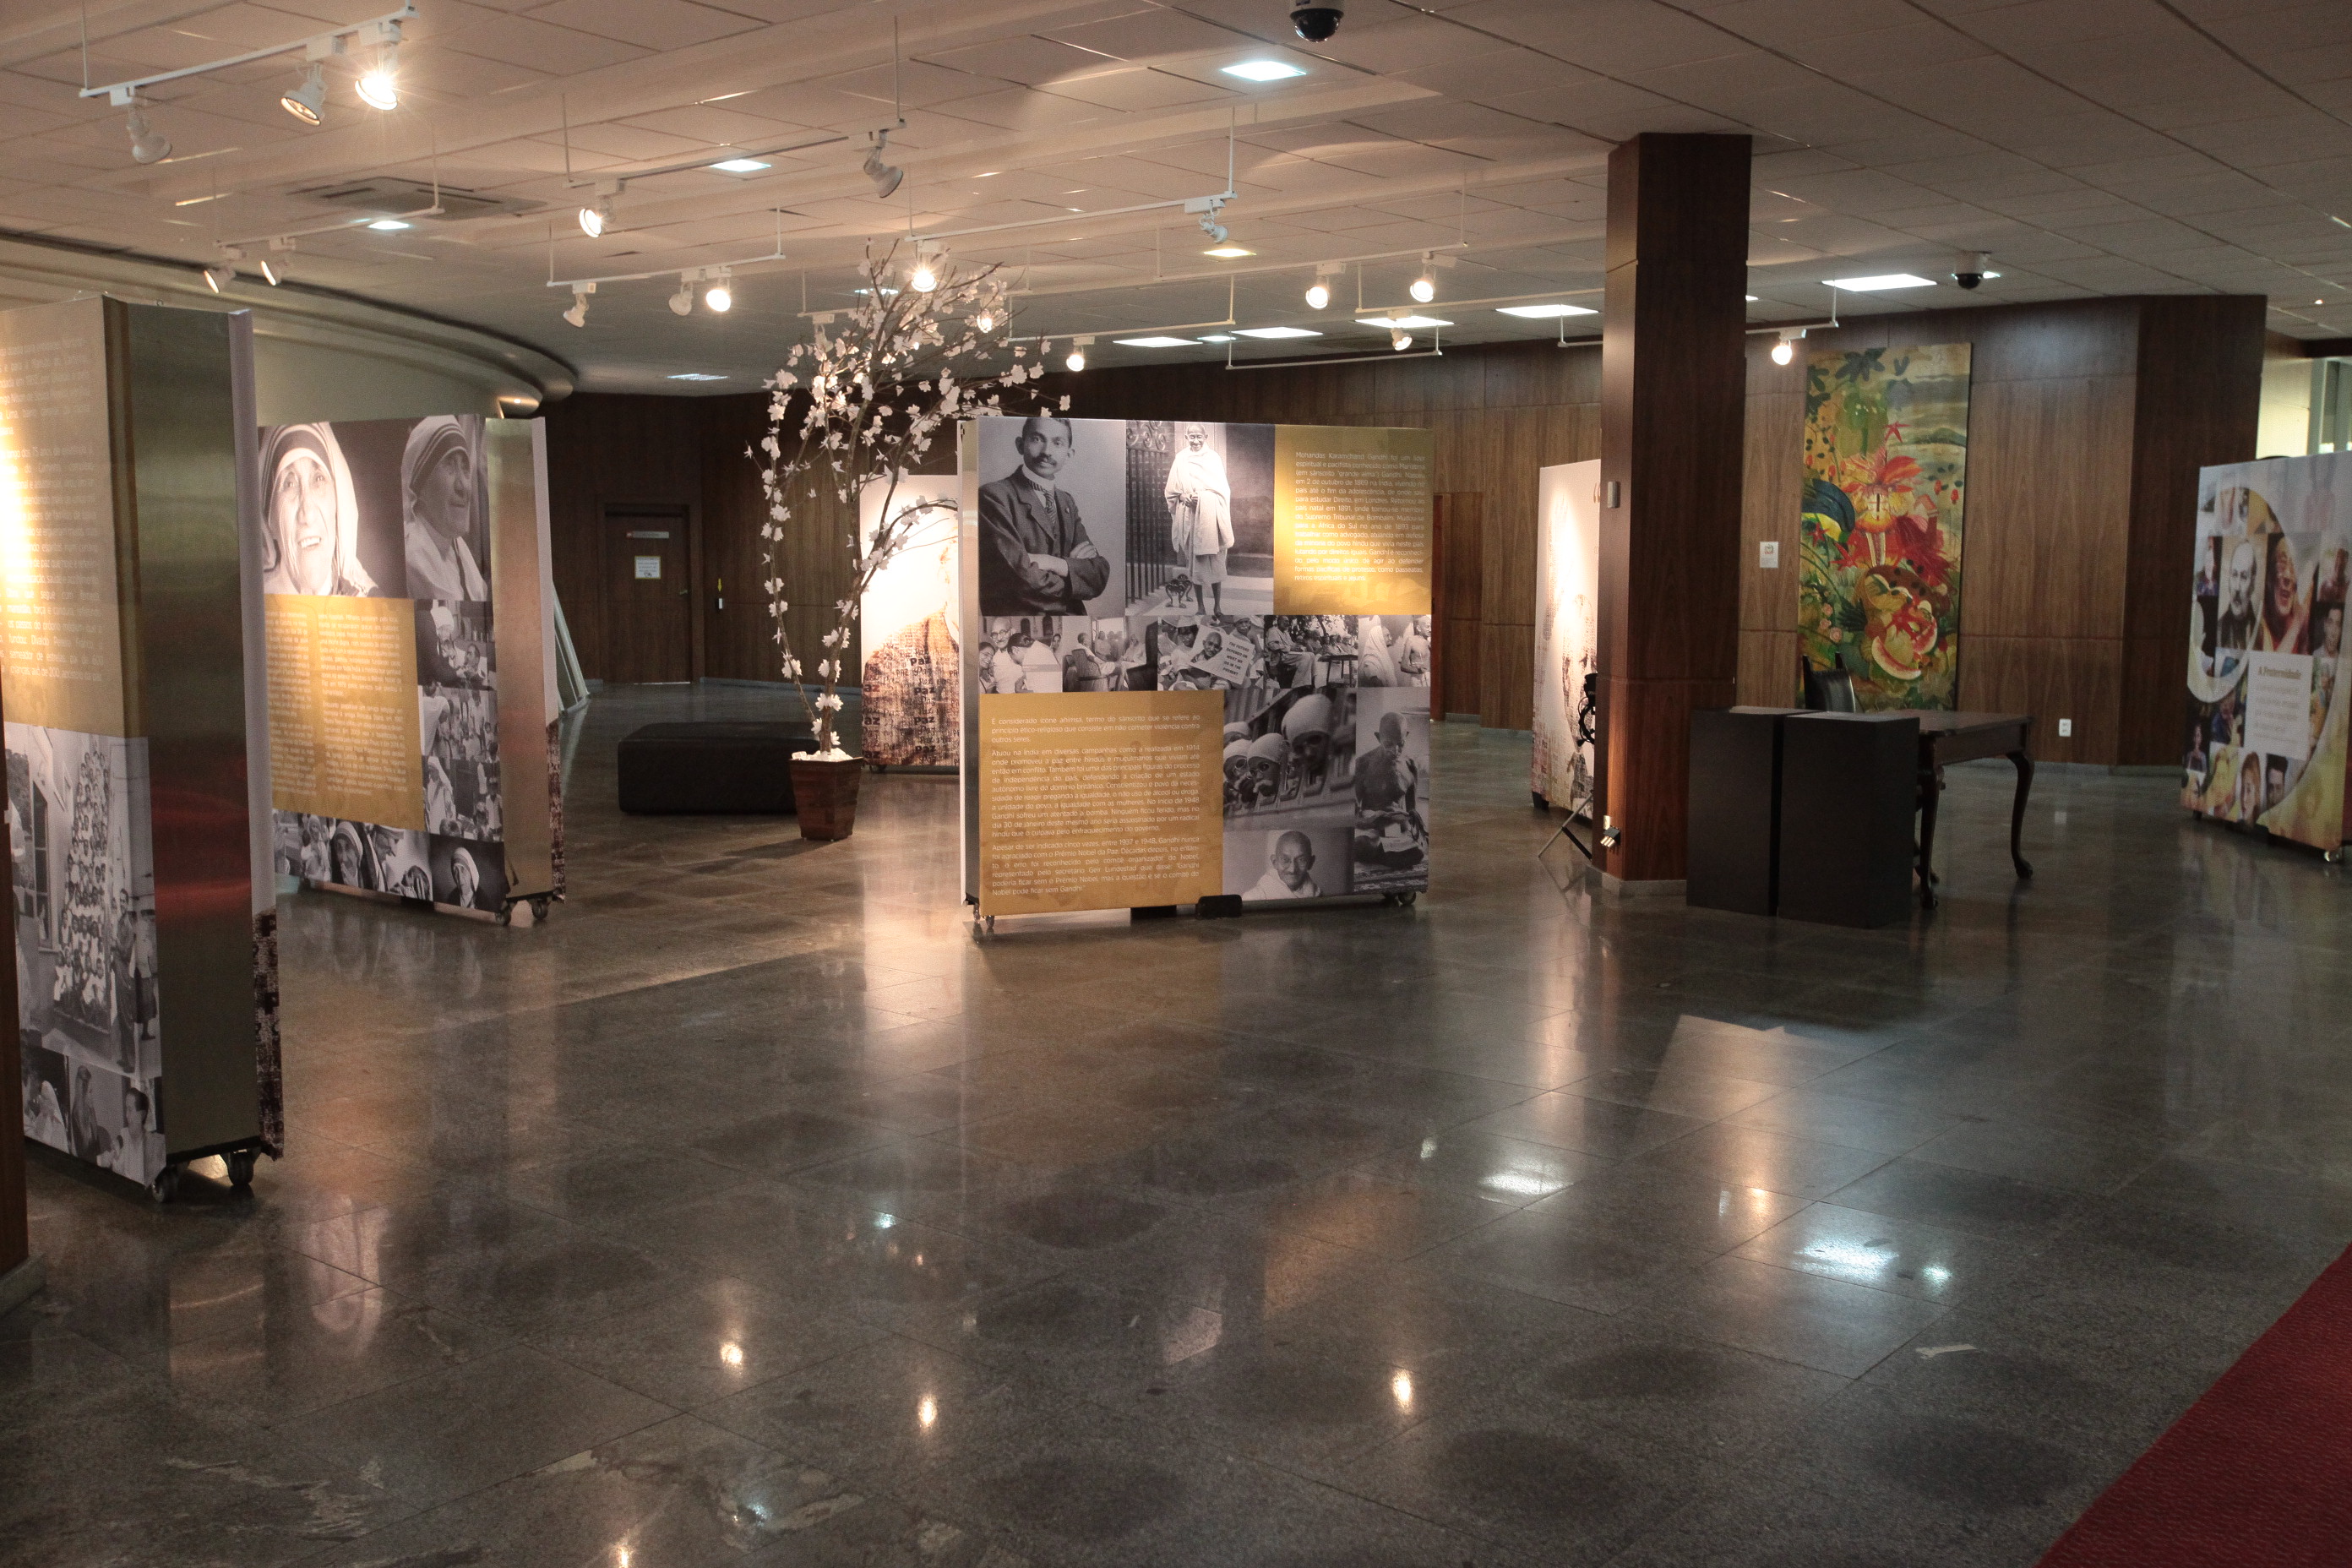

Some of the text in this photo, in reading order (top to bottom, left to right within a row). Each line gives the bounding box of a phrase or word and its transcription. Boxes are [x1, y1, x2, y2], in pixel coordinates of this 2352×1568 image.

[910, 656, 931, 666] paz
[914, 687, 935, 695] paz
[863, 716, 935, 725] az paz
